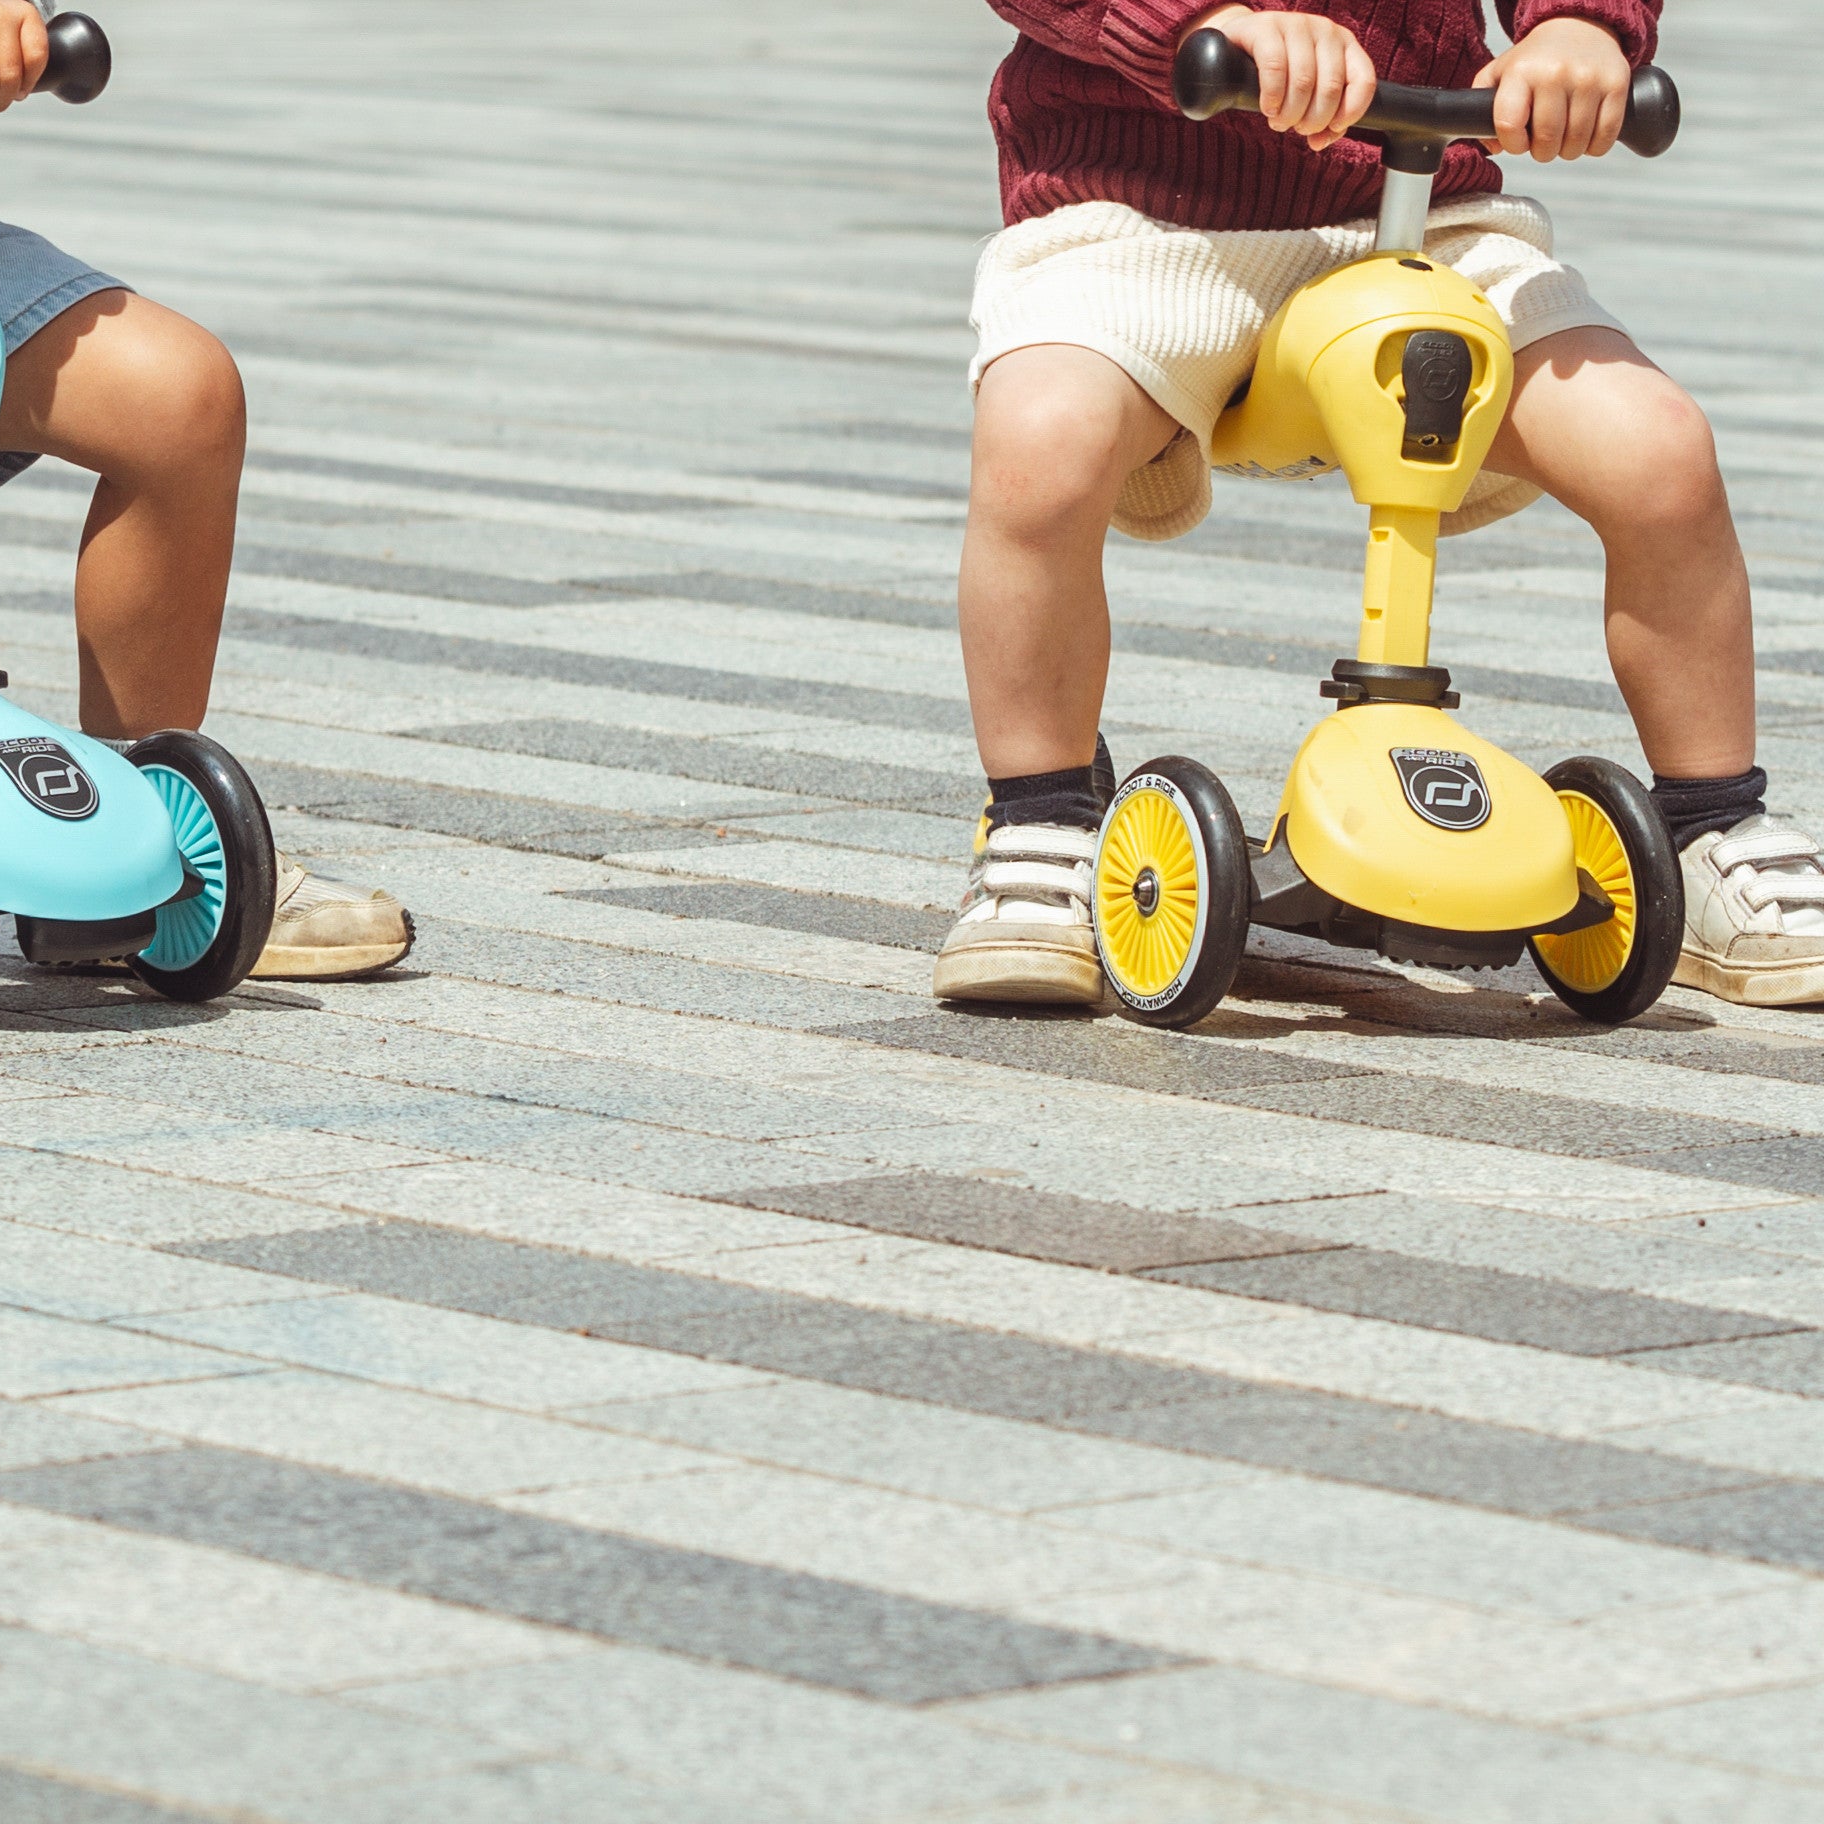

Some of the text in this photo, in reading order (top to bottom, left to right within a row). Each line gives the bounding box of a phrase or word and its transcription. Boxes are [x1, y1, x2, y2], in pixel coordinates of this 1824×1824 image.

[22, 744, 57, 754] RIDE
[1402, 749, 1462, 758] SCOOT
[1425, 757, 1466, 767] RIDE
[1113, 777, 1143, 808] SCOOT
[1154, 778, 1176, 799] RIDE
[1121, 978, 1183, 1011] HIGHWAYKICK
